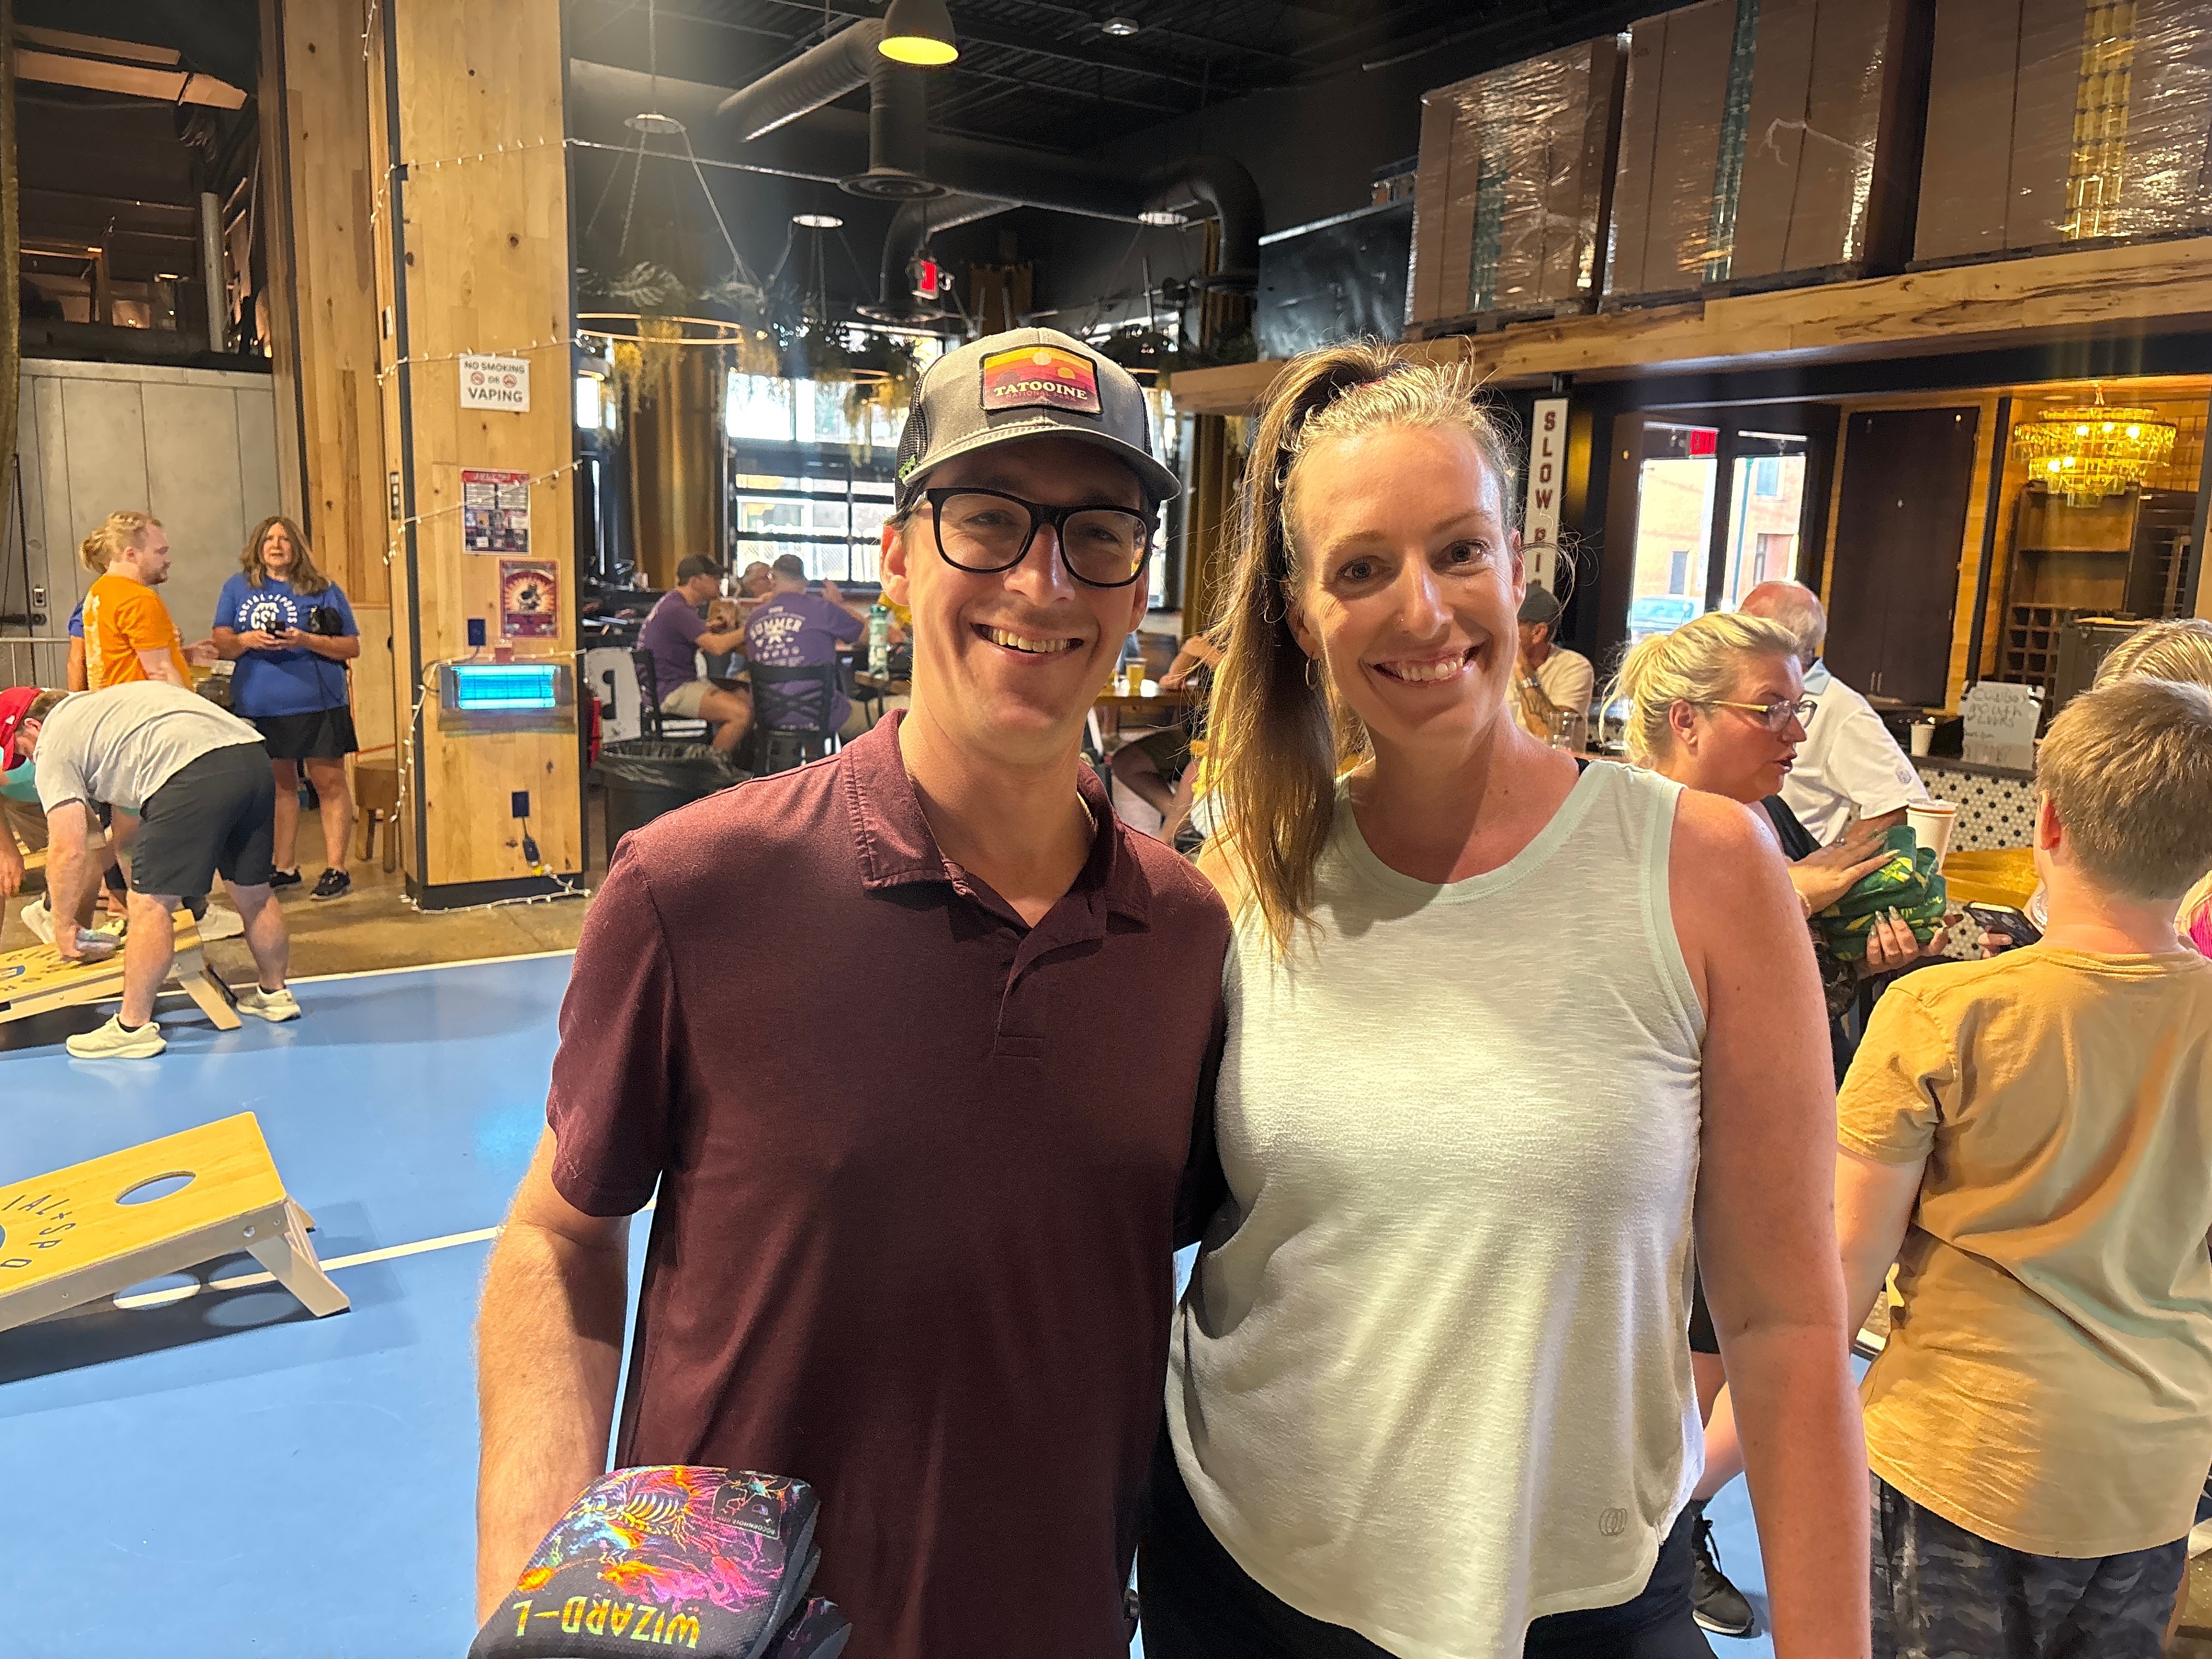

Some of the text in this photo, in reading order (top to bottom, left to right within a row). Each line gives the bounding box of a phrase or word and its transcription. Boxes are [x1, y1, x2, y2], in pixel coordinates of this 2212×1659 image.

[464, 360, 525, 374] NO SMOKING
[488, 375, 500, 383] OR
[467, 387, 523, 403] VAPING
[994, 381, 1088, 400] TATOOINE
[1006, 390, 1077, 403] NATIONAL PARK
[1535, 410, 1556, 509] SLOW
[512, 1595, 700, 1649] WIZARD-L
